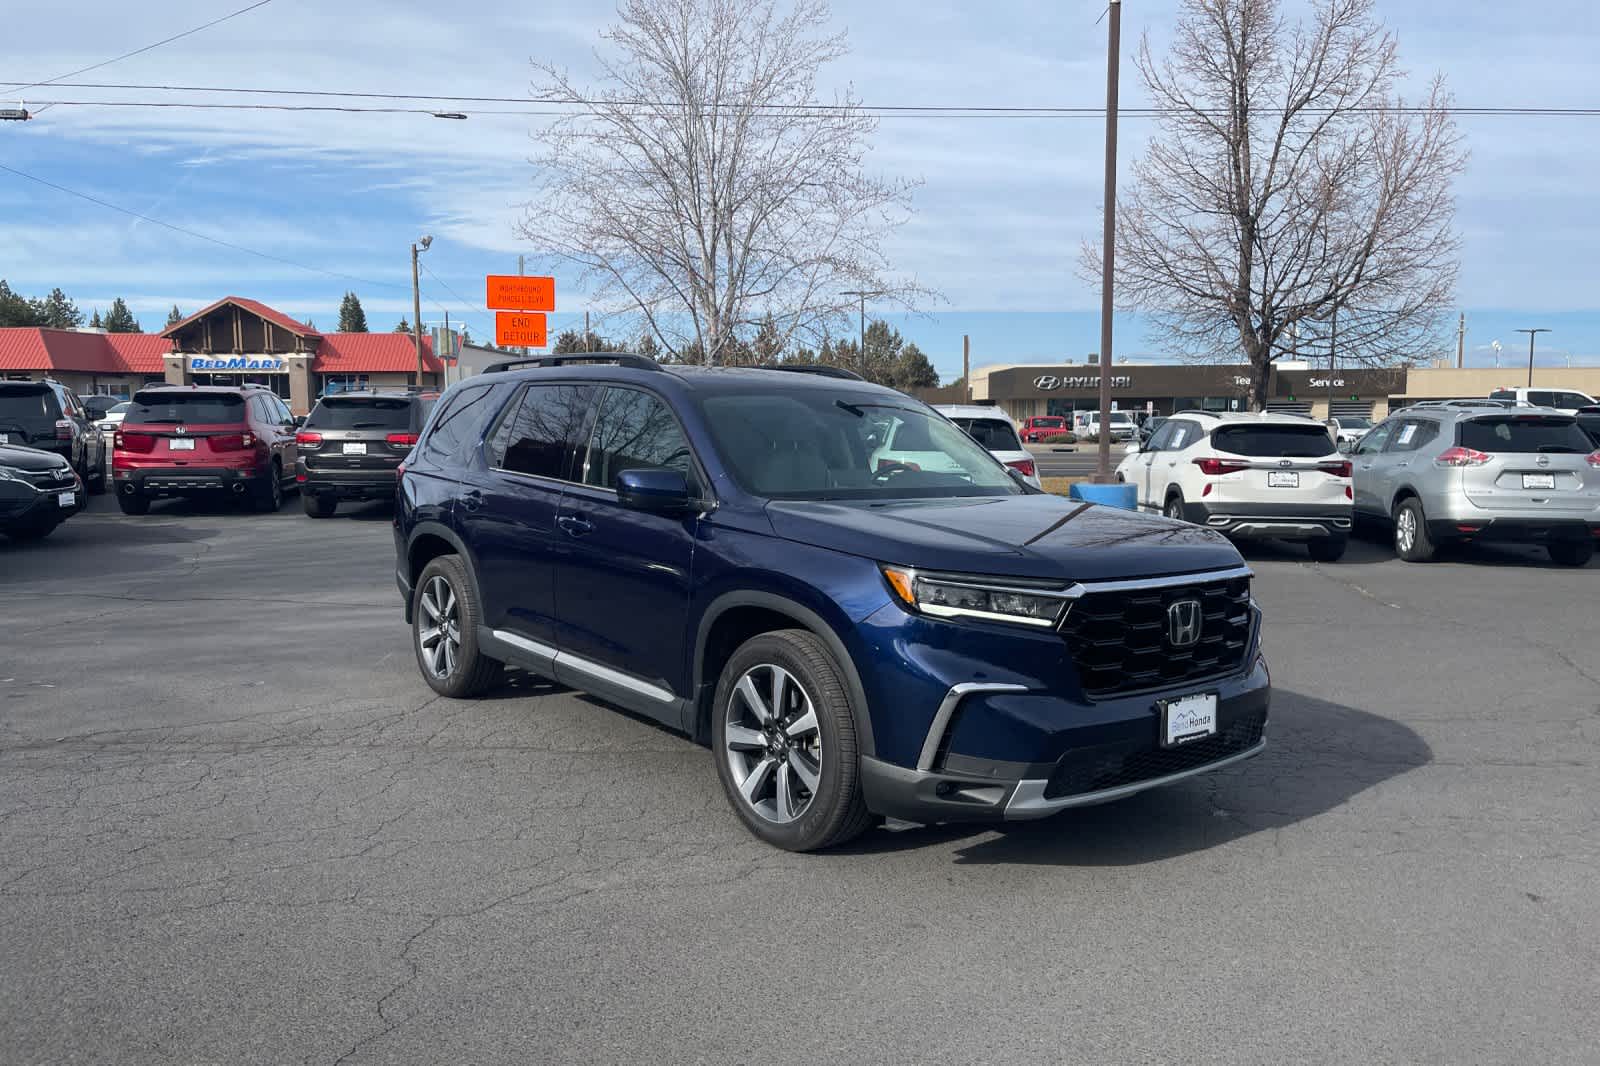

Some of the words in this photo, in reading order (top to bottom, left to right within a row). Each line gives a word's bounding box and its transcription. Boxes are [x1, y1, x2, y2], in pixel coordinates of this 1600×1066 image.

[512, 317, 530, 328] END
[504, 331, 539, 342] DETOUR
[1309, 378, 1345, 387] Servce
[1189, 715, 1211, 728] Honda
